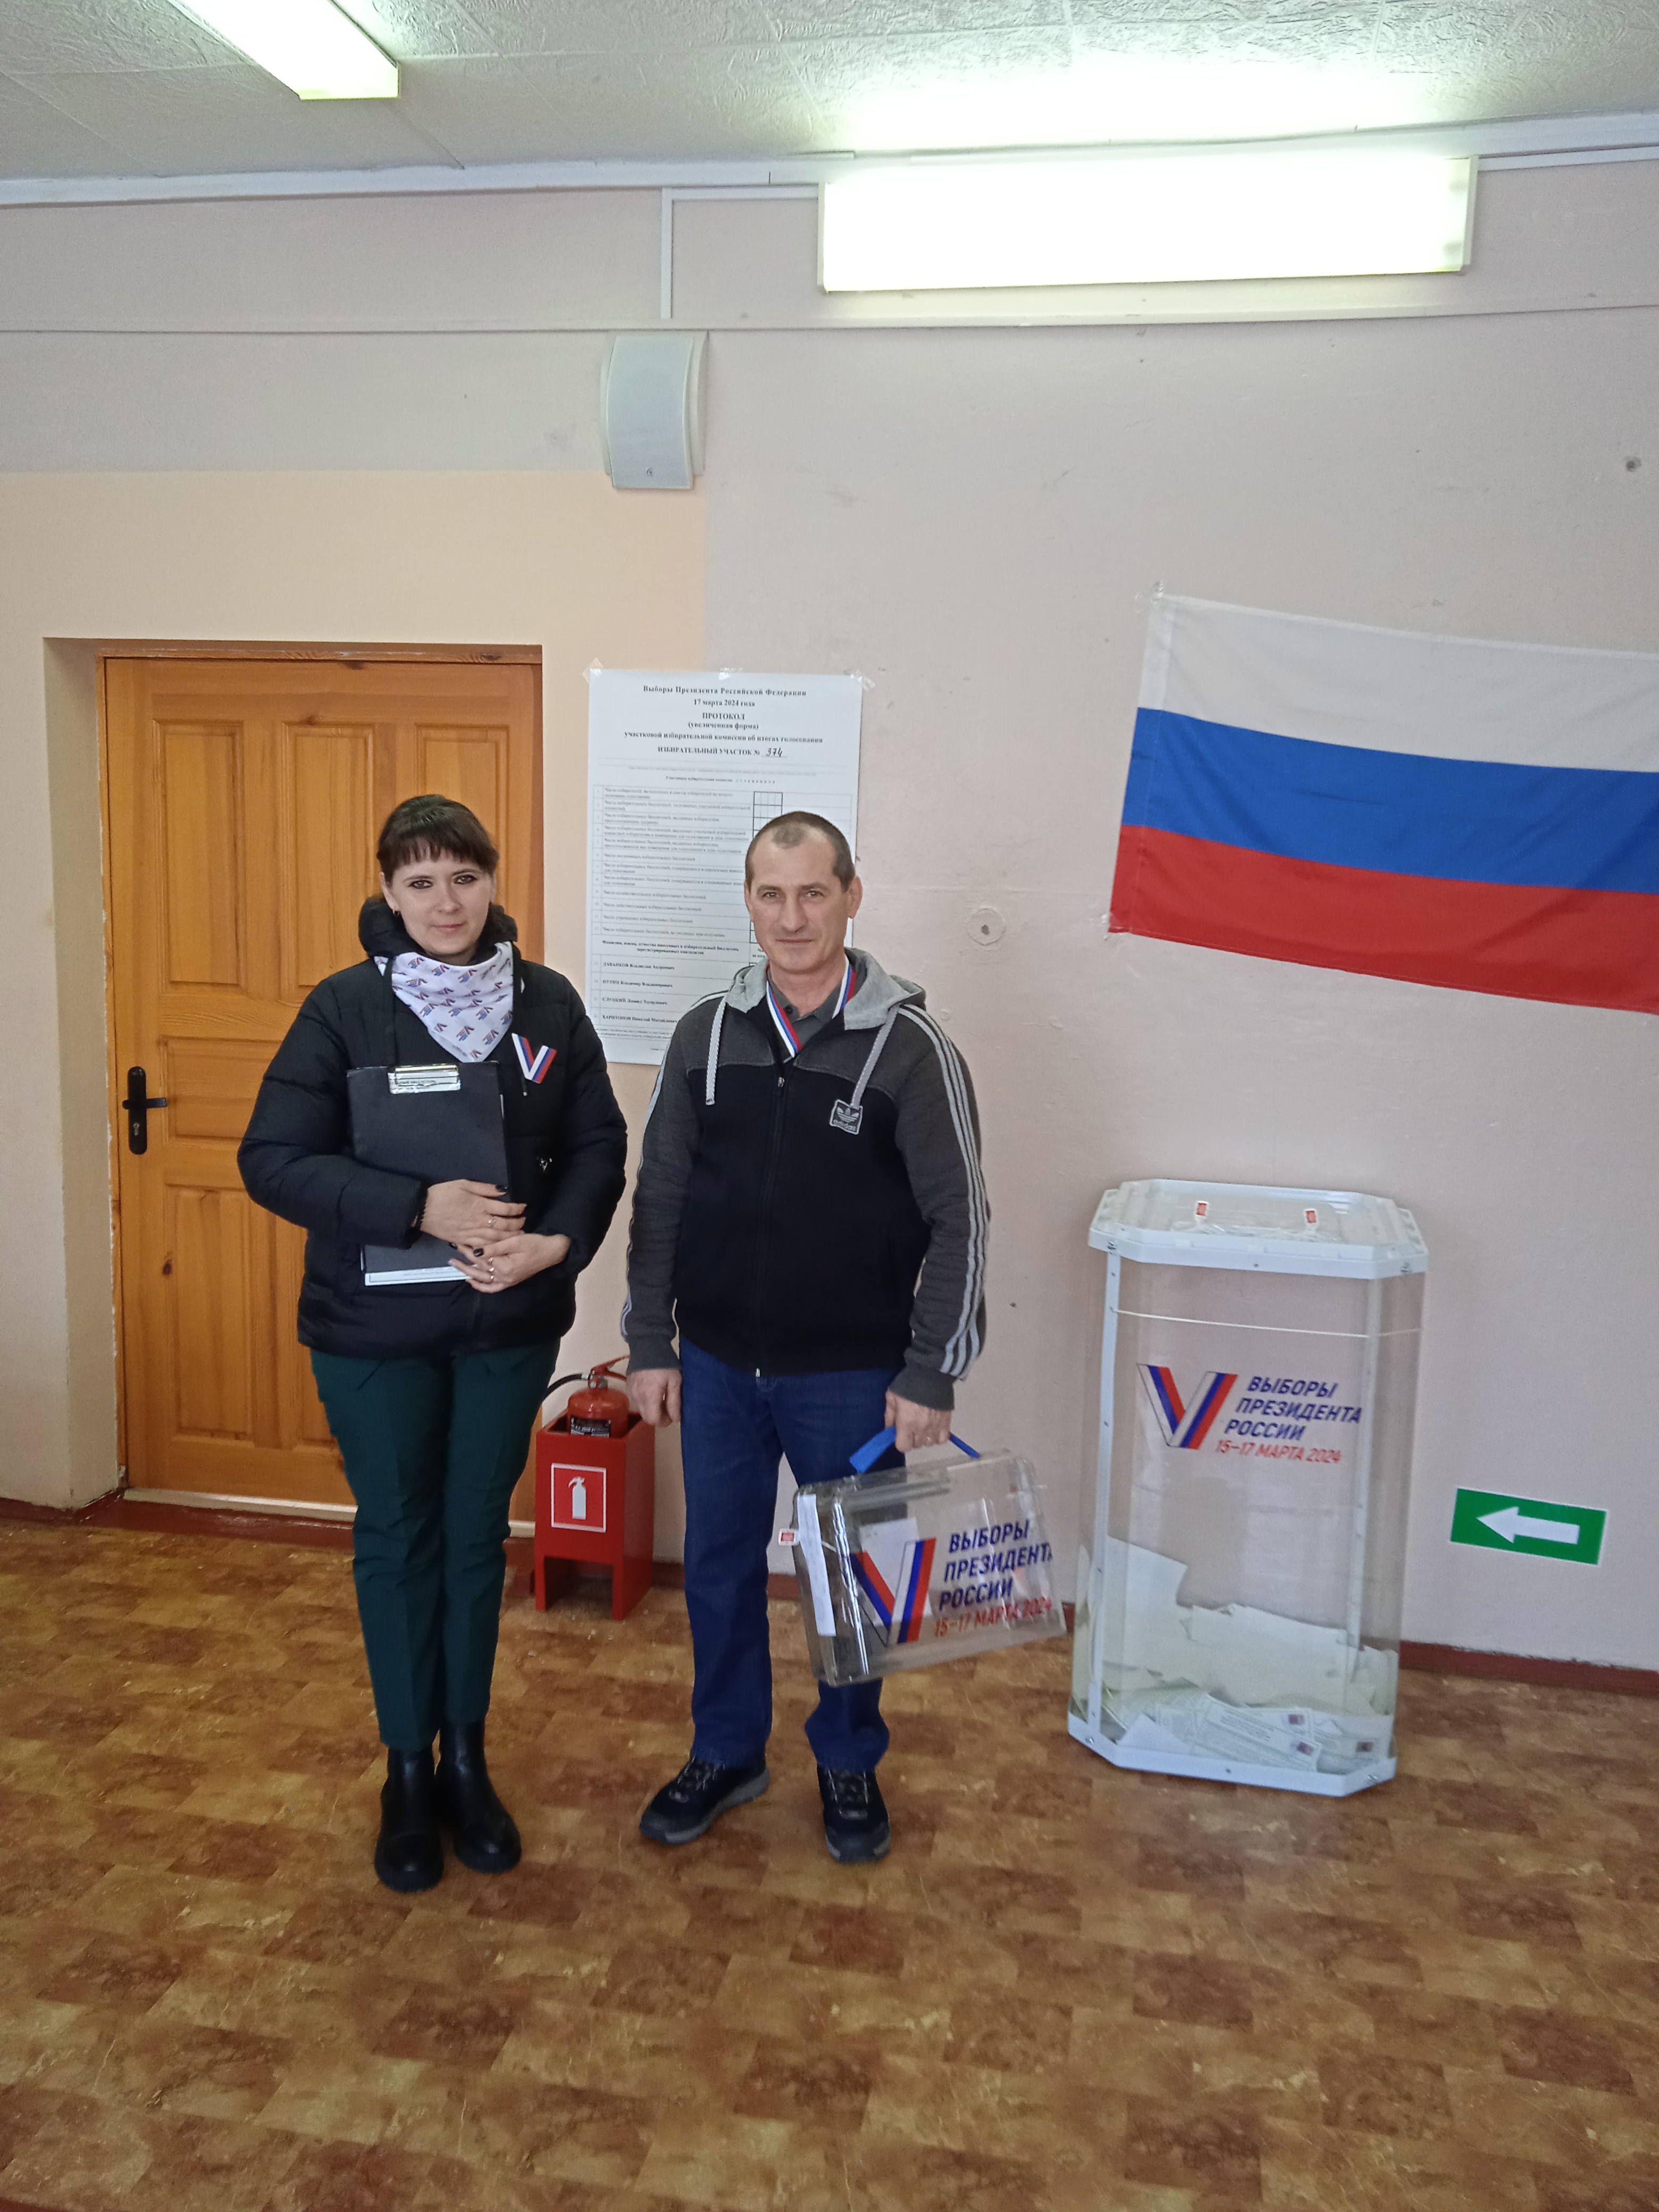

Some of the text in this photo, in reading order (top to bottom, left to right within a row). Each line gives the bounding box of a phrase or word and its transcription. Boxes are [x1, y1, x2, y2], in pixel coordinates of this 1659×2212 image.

[643, 685, 673, 694] Выборы
[766, 688, 807, 697] Федерации
[766, 747, 783, 757] 374
[1247, 1376, 1339, 1399] ВЫБОРЫ
[1235, 1397, 1362, 1424] ПРЕЗИДЕНТА
[1224, 1419, 1306, 1440] РОССИИ
[1255, 1444, 1305, 1461] МАРТА
[1306, 1447, 1342, 1464] 2024
[949, 1519, 1030, 1554] ВЫБОРЫ
[939, 1578, 1013, 1612] РОССИИ
[974, 1603, 1018, 1630] МАРТА
[1021, 1595, 1052, 1619] 2024
